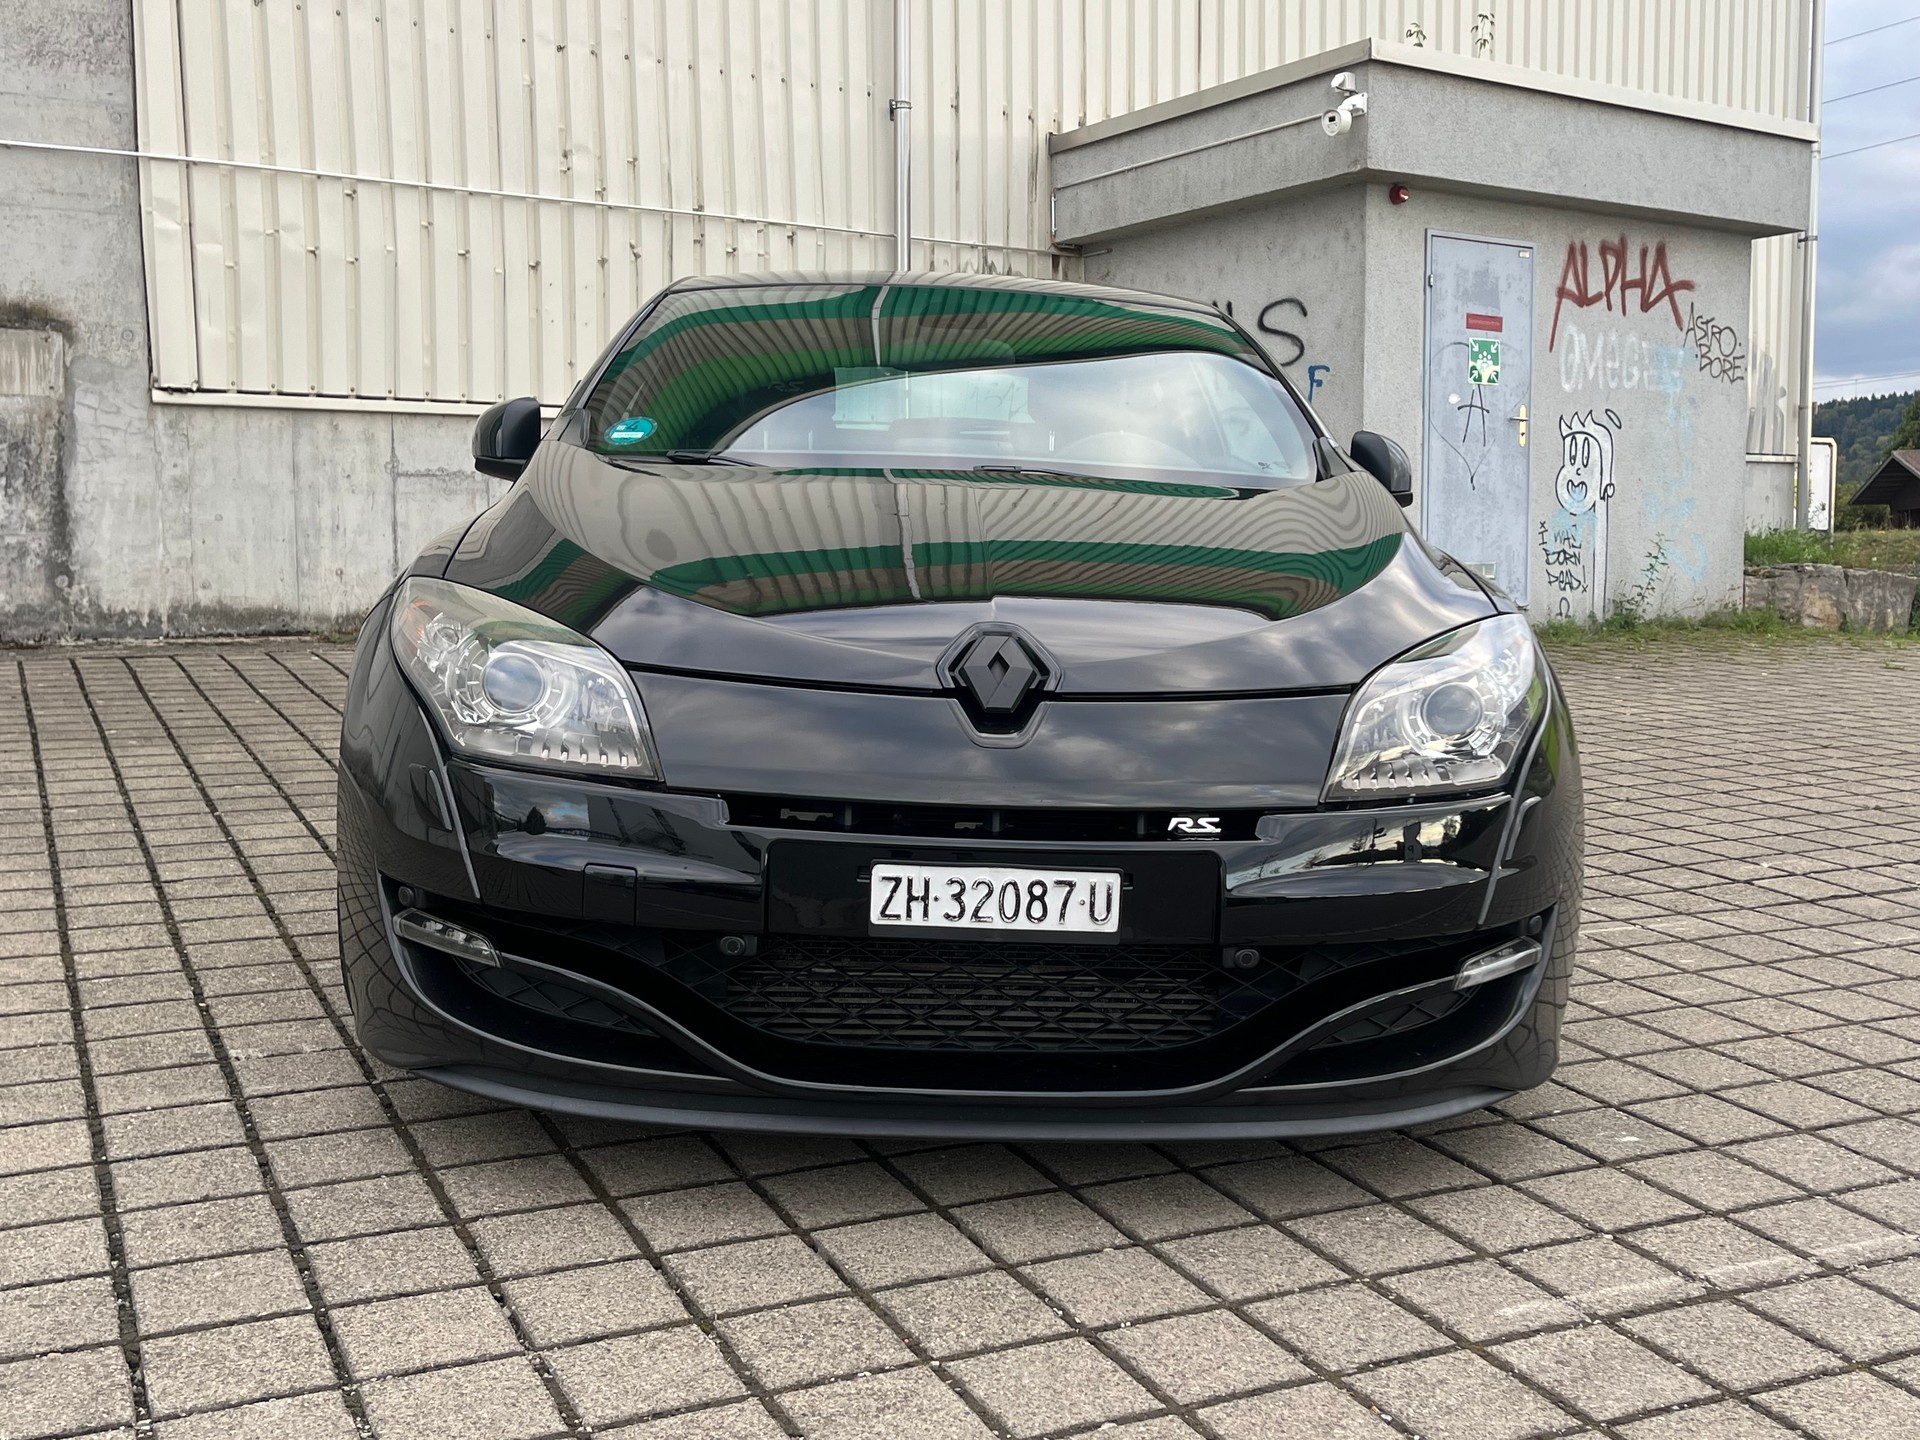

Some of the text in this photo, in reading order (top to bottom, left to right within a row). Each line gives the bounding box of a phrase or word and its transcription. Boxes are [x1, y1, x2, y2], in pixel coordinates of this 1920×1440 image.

[1550, 233, 1695, 352] ALPHA
[1542, 547, 1581, 566] BORN
[1167, 817, 1222, 833] RS
